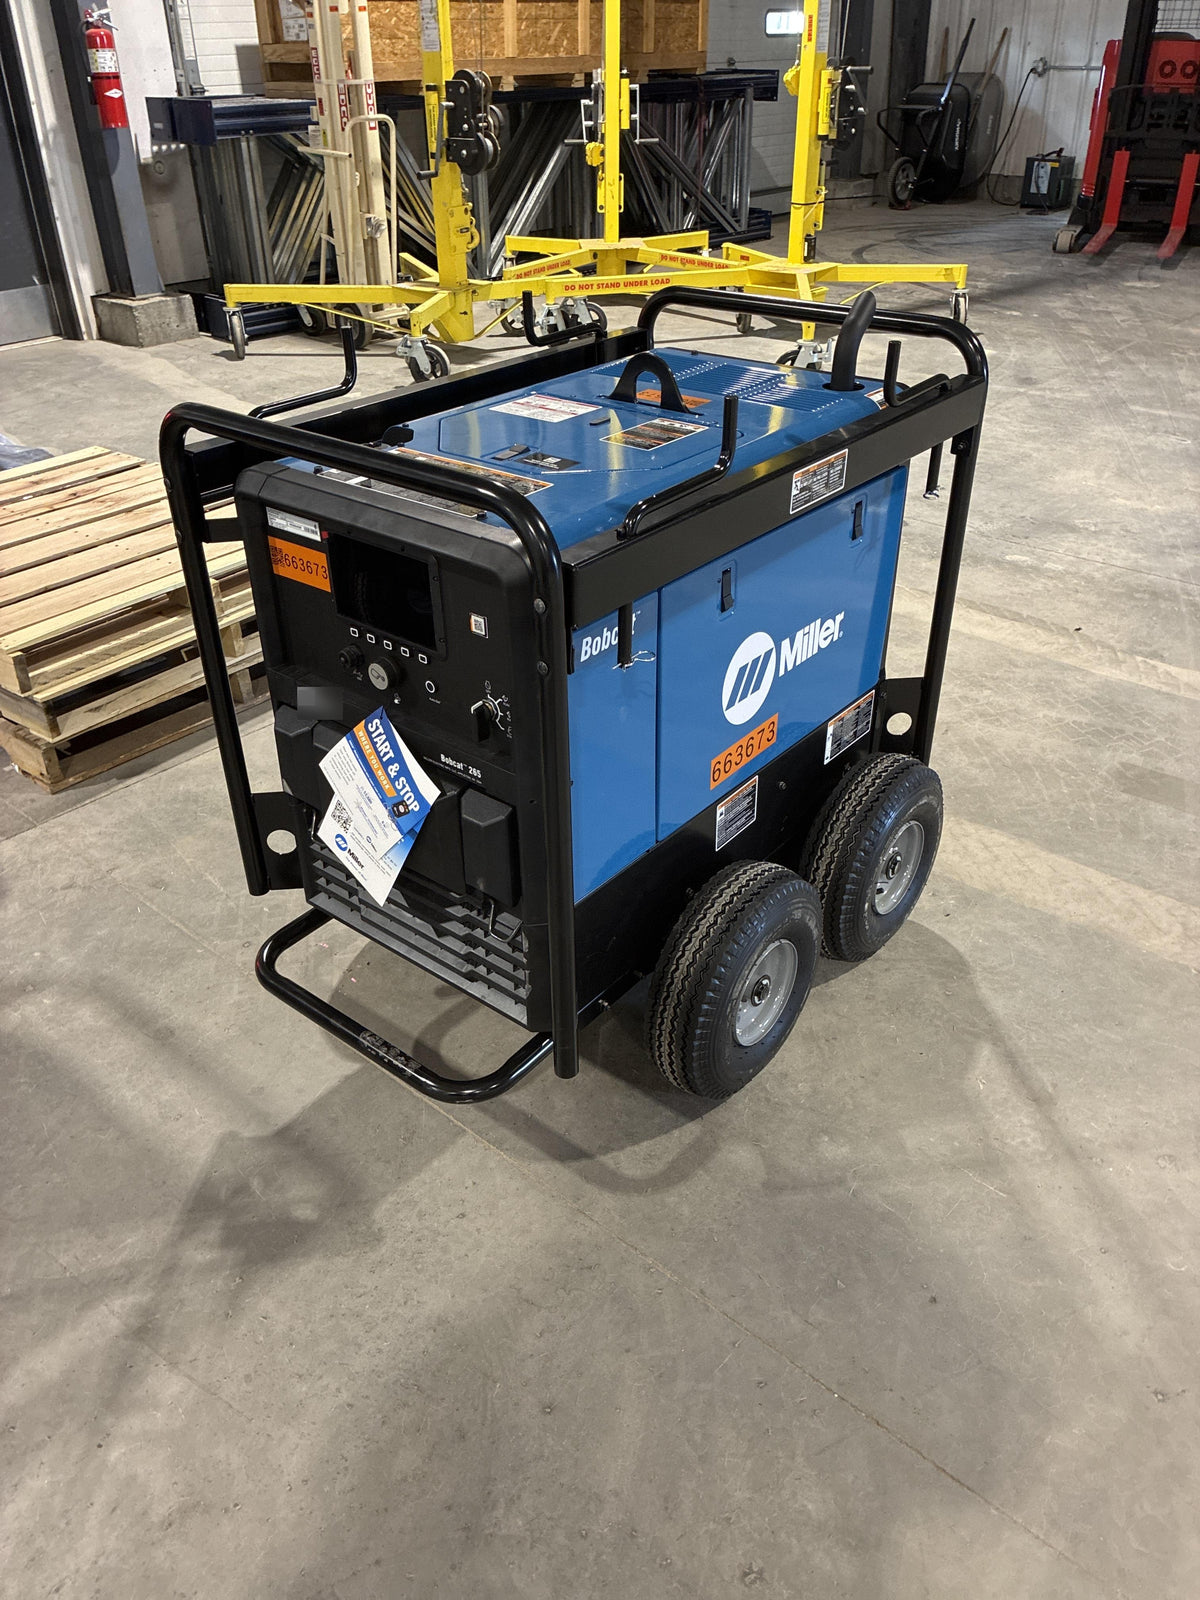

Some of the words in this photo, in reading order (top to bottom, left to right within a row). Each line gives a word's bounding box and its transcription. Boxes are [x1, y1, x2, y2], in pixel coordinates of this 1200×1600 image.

[523, 270, 532, 278] NOT
[532, 266, 546, 275] STAND
[547, 262, 559, 271] UNDER
[560, 259, 571, 267] LOAD
[669, 255, 679, 263] NOT
[680, 257, 695, 265] STAND
[697, 260, 713, 268] UNDER
[579, 283, 594, 291] NOT
[284, 553, 328, 580] 663673
[358, 730, 372, 755] WHERE
[369, 754, 379, 769] YOU
[377, 769, 390, 790] WORK
[712, 720, 775, 782] 663673
[368, 718, 395, 762] START
[387, 762, 400, 778] &
[394, 776, 420, 812] STOP
[468, 765, 482, 778] 265
[347, 848, 364, 869] Miller
